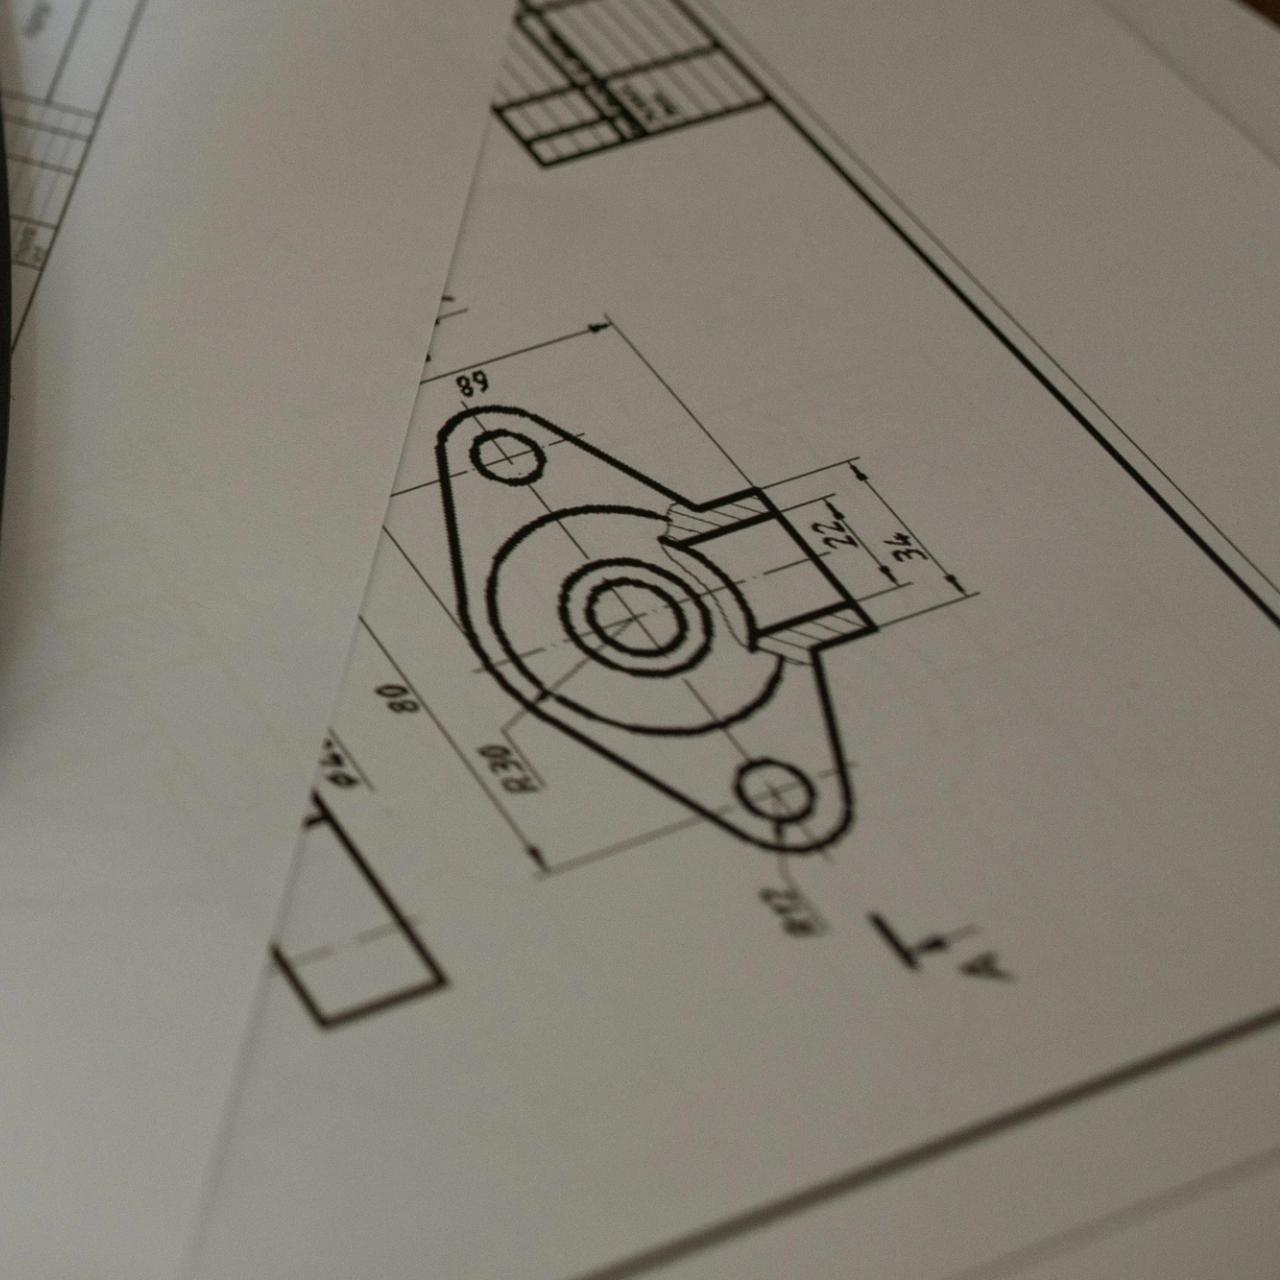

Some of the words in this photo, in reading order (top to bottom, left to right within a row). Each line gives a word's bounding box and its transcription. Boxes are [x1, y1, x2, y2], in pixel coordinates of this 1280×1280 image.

[811, 520, 859, 551] 22
[883, 530, 929, 563] 34
[375, 683, 421, 714] 80
[478, 743, 537, 795] R30
